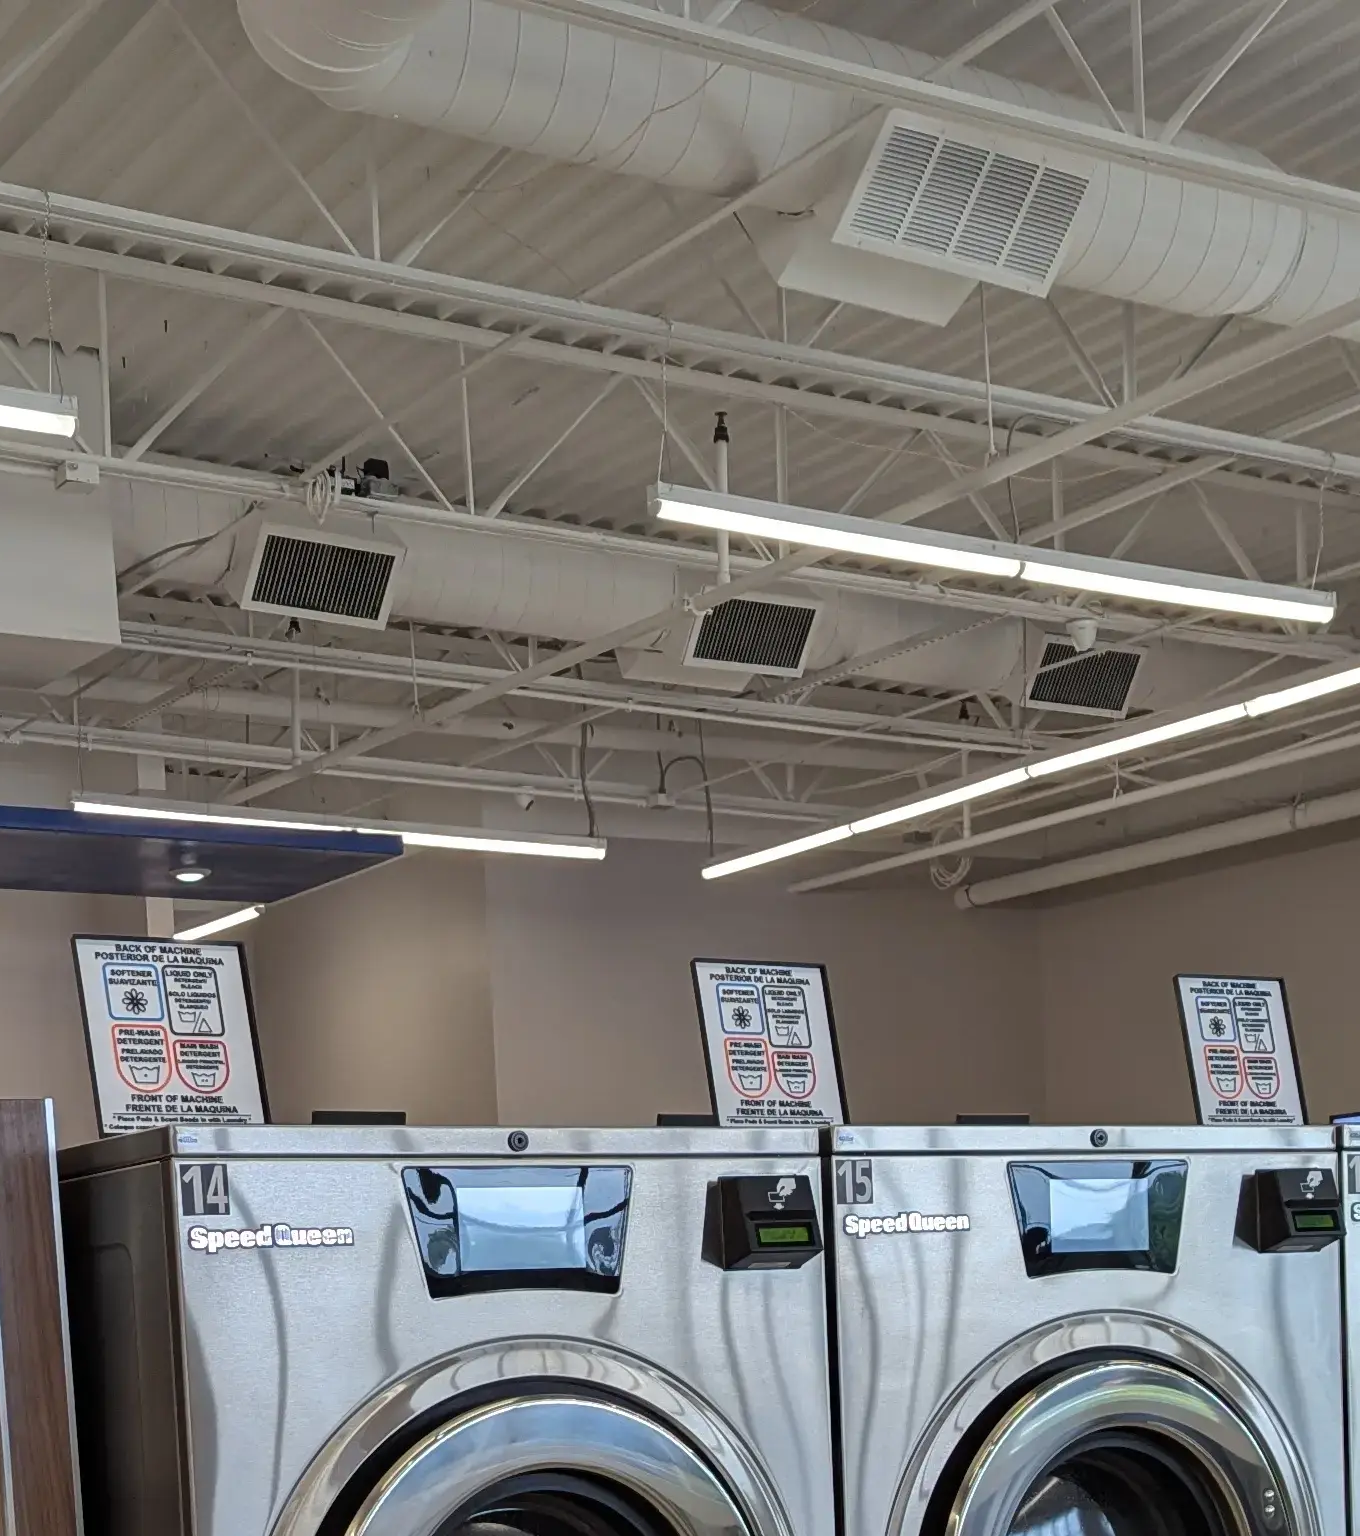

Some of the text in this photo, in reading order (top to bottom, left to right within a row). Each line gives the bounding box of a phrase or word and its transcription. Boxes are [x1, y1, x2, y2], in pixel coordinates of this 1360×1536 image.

[115, 943, 202, 956] BACK OF MACHINE
[95, 952, 224, 966] POSTERIOR DE LA MAQUINA
[110, 969, 152, 978] SOFTENER
[165, 970, 191, 978] LIQUID
[748, 967, 757, 975] OF
[759, 968, 792, 976] MACHINE
[108, 978, 159, 987] SUAVIZANTE
[710, 974, 752, 982] POSTERIOR
[117, 1038, 164, 1046] DETERGENT
[131, 1094, 224, 1104] FRONT OF MACHINE
[779, 1100, 811, 1108] MACHINE
[125, 1104, 238, 1114] FRENTE DE LA MAQUINA
[736, 1108, 765, 1116] FRENTE
[767, 1108, 776, 1116] DE
[837, 1160, 871, 1203] 15
[182, 1165, 228, 1214] 14
[844, 1211, 970, 1238] Speed Queen
[189, 1223, 354, 1253] Speed Queen
